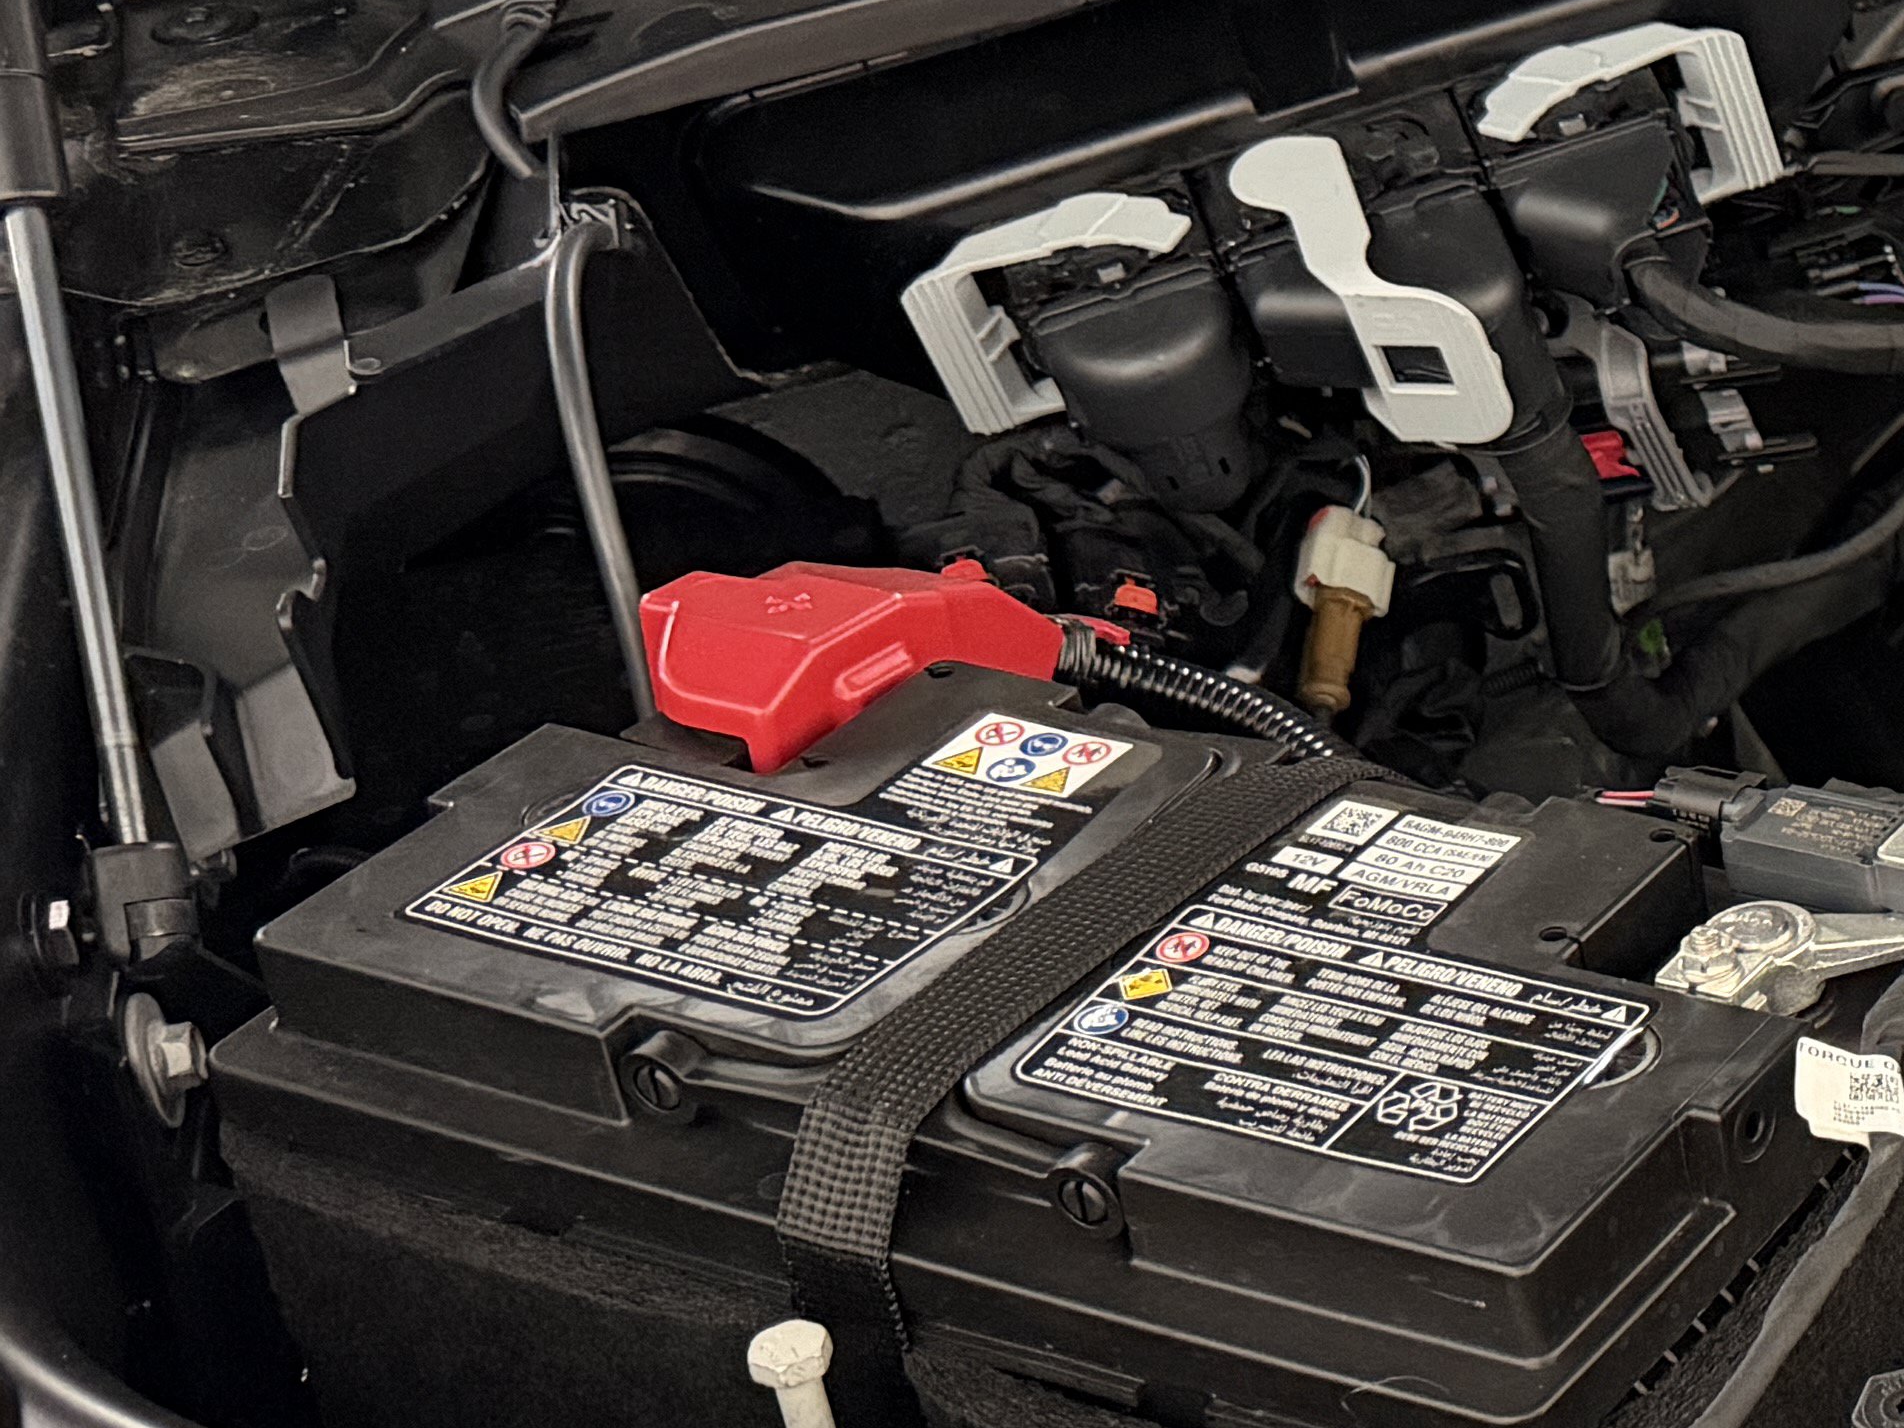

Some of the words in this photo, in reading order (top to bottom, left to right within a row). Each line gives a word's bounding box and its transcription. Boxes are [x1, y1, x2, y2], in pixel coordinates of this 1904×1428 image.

[1292, 853, 1325, 866] 12V
[1414, 843, 1442, 855] CCA
[1375, 854, 1398, 864] 80
[1401, 860, 1426, 871] Ah
[1429, 865, 1464, 878] C20
[1286, 873, 1337, 895] MF
[1352, 867, 1451, 897] AGM/VRLA
[421, 900, 452, 914] DO
[444, 906, 482, 921] NOT
[1339, 891, 1434, 921] FoMoCo
[522, 925, 551, 939] NE
[543, 931, 580, 946] PAS
[633, 953, 664, 967] NO
[655, 958, 686, 972] LA
[1213, 918, 1352, 958] DANGER/POISON
[1382, 955, 1525, 996] PELIGRO/VENENO
[1056, 1047, 1090, 1060] Lead
[1089, 1055, 1121, 1068] Acid
[1117, 1063, 1169, 1082] Battery
[1065, 1038, 1177, 1070] NON-SPILLABLE
[1800, 1042, 1875, 1069] TORQUE
[1032, 1068, 1066, 1081] ANTI
[1044, 1057, 1096, 1075] Batterie
[1094, 1071, 1112, 1080] au
[1112, 1074, 1157, 1091] plomb
[1212, 1072, 1272, 1092] CONTRA
[1269, 1085, 1352, 1111] DERRAMES
